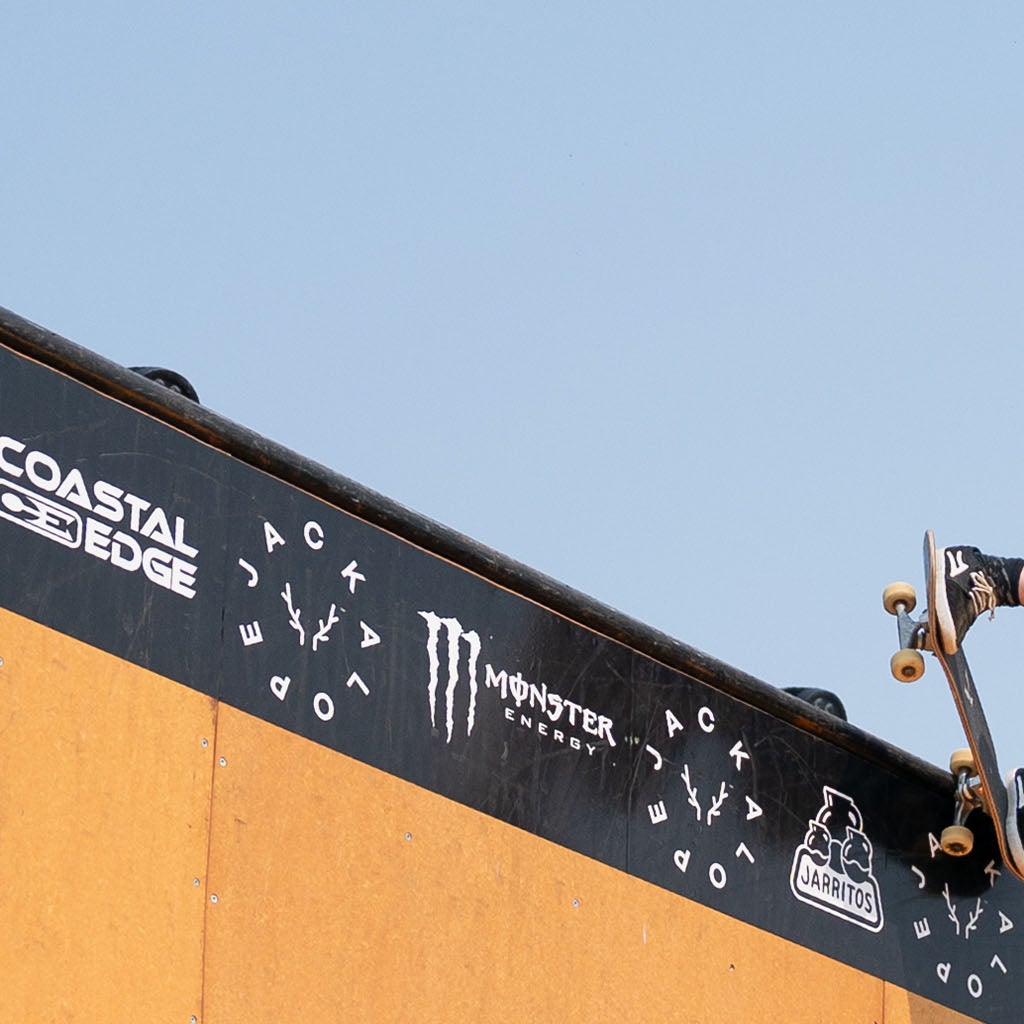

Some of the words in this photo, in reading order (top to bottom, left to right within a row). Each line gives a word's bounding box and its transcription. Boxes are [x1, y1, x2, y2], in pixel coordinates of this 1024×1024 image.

[0, 436, 199, 558] COASTAL
[84, 517, 198, 599] EDGE
[505, 708, 596, 756] ENERGY
[800, 865, 873, 915] JARRITOS
[911, 831, 1014, 998] JAKALOPE
